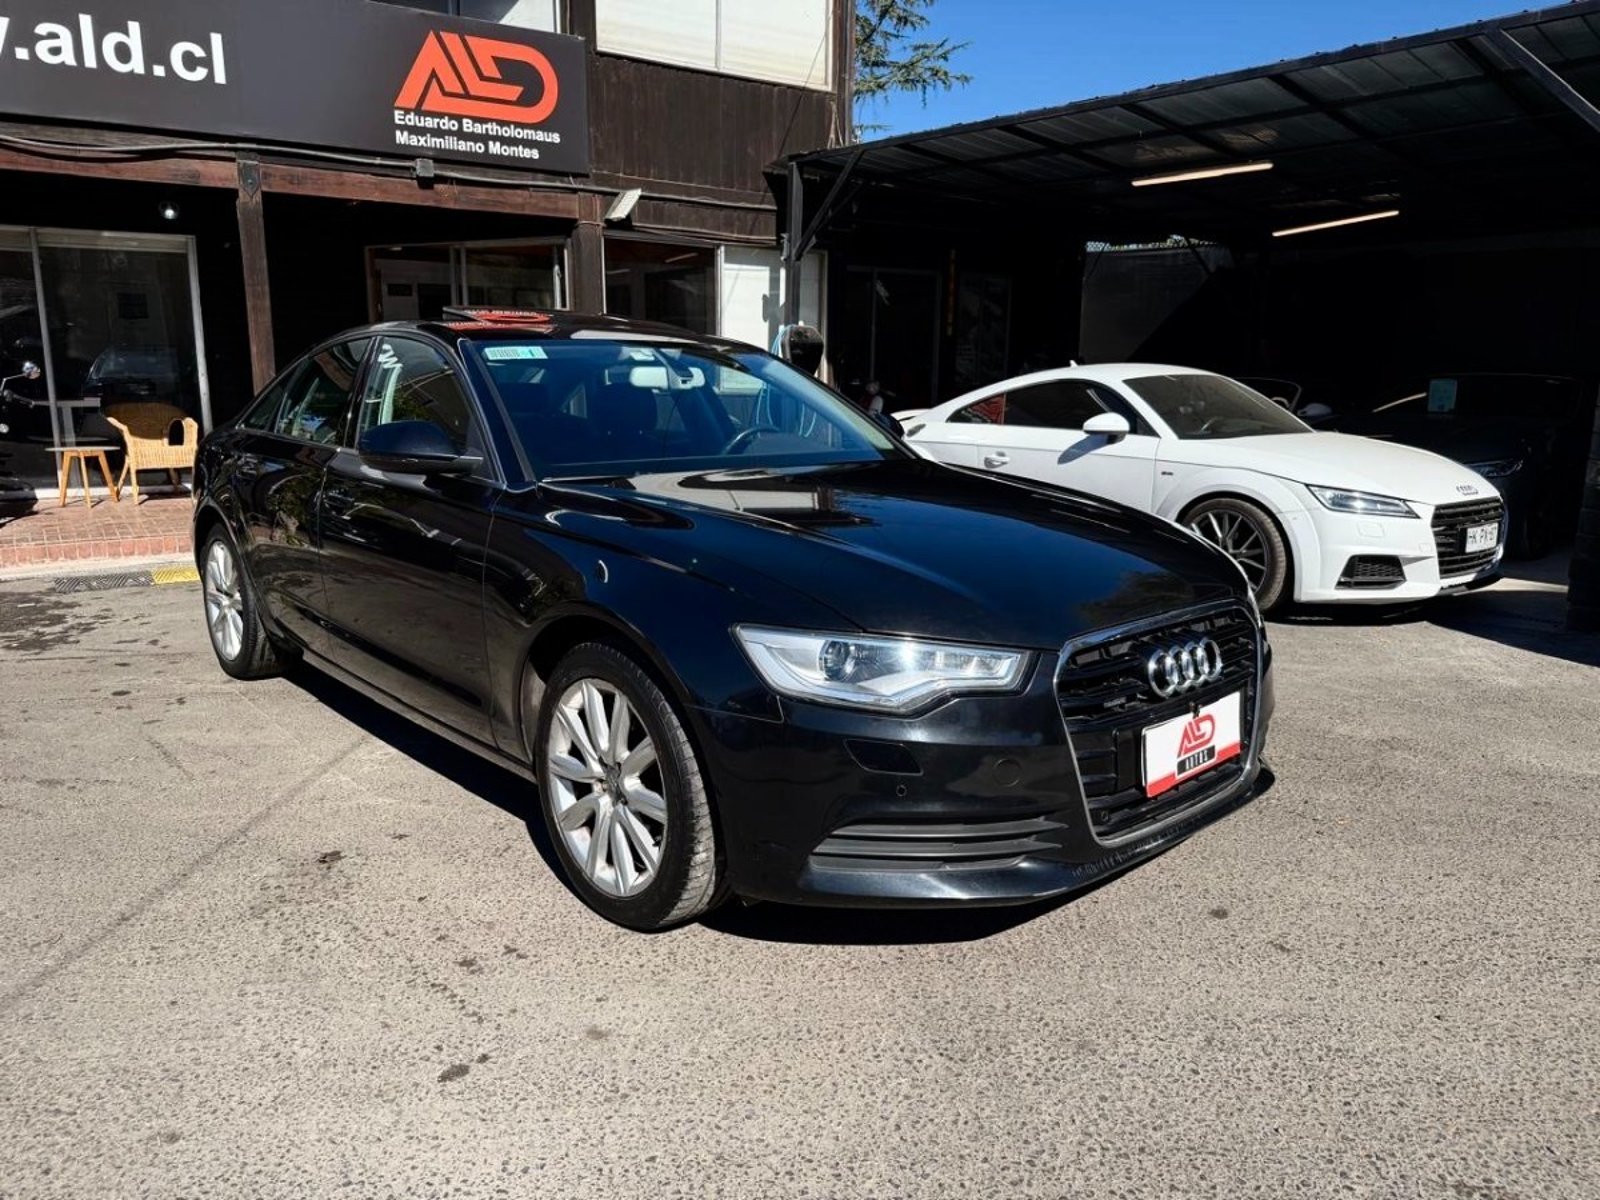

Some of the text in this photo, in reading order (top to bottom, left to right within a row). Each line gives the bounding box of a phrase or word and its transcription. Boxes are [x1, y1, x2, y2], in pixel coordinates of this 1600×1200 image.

[0, 13, 227, 85] .ald.cl
[394, 30, 558, 124] ALD
[394, 110, 561, 144] Eduardo Bartholomaus
[395, 129, 540, 160] Maximiliano Montes
